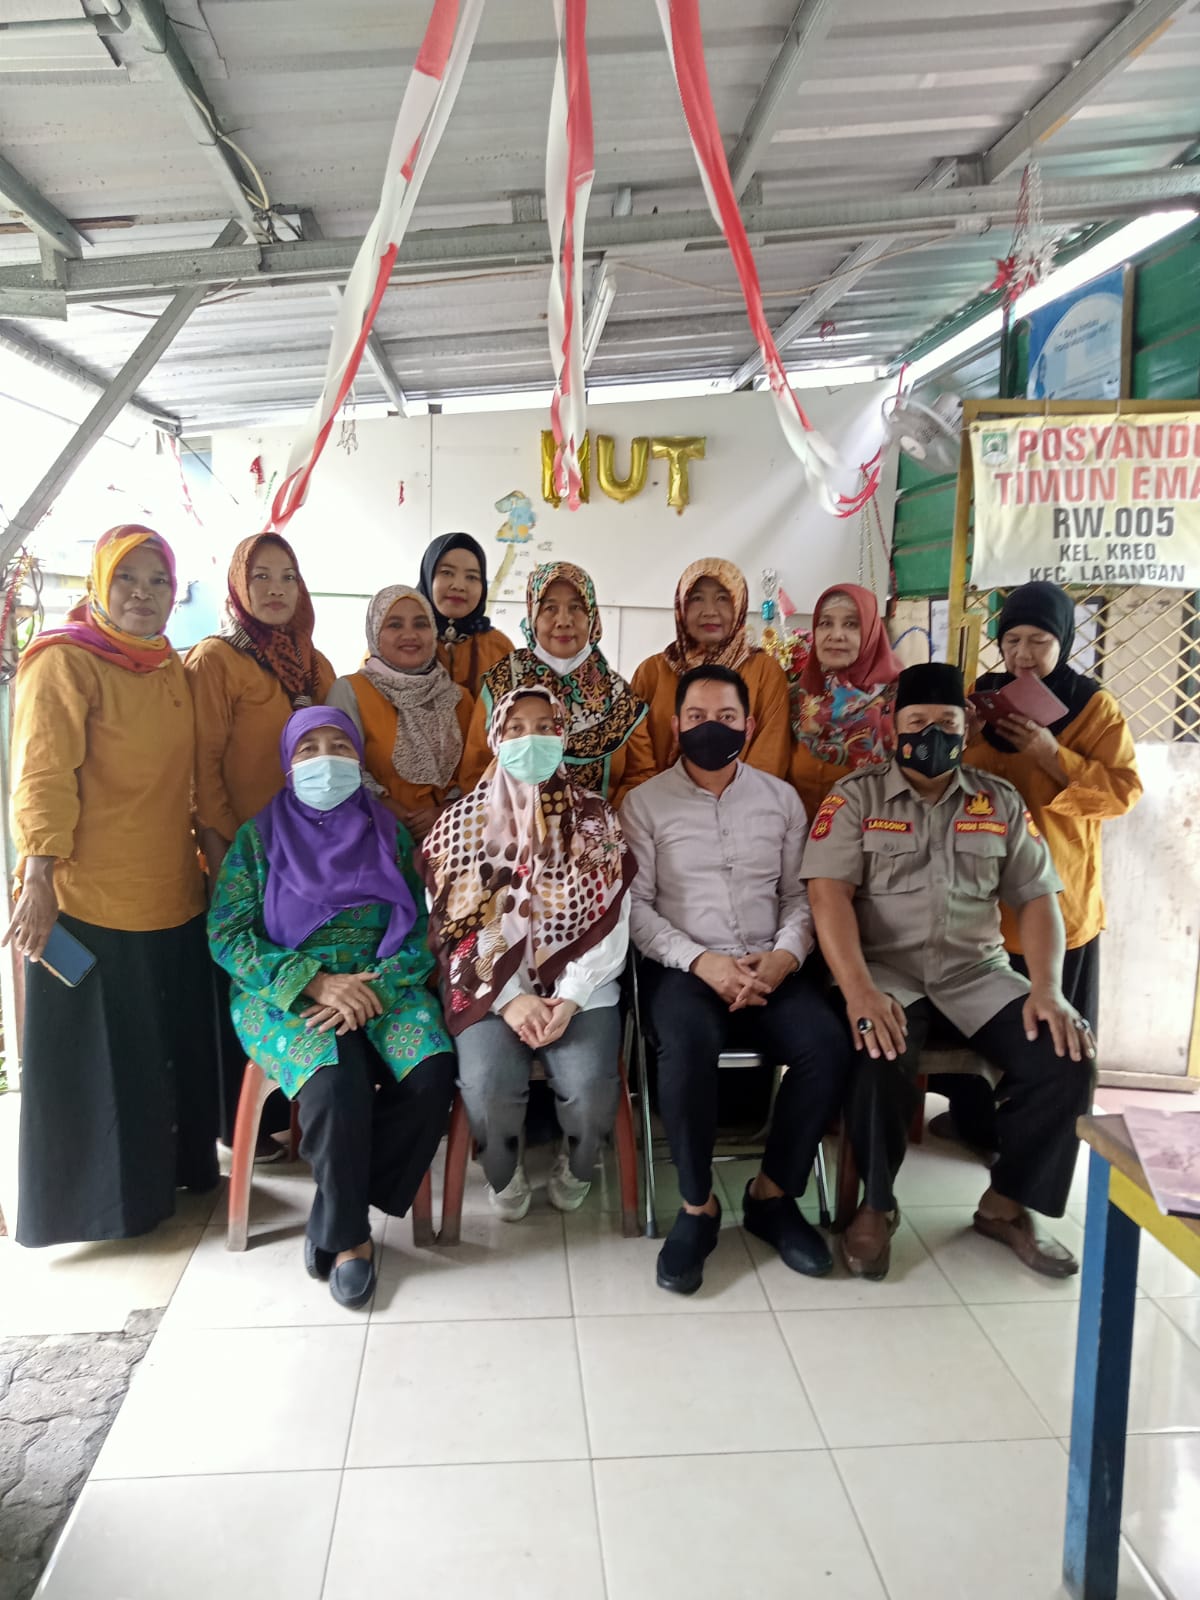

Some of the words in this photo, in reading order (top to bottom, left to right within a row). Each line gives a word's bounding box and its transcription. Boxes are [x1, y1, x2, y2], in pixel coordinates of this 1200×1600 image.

[994, 467, 1116, 505] TIMUN
[1052, 506, 1175, 540] RW.005
[1059, 544, 1099, 562] KEL.
[1107, 543, 1156, 561] KREO
[1080, 564, 1185, 583] LARANGAN
